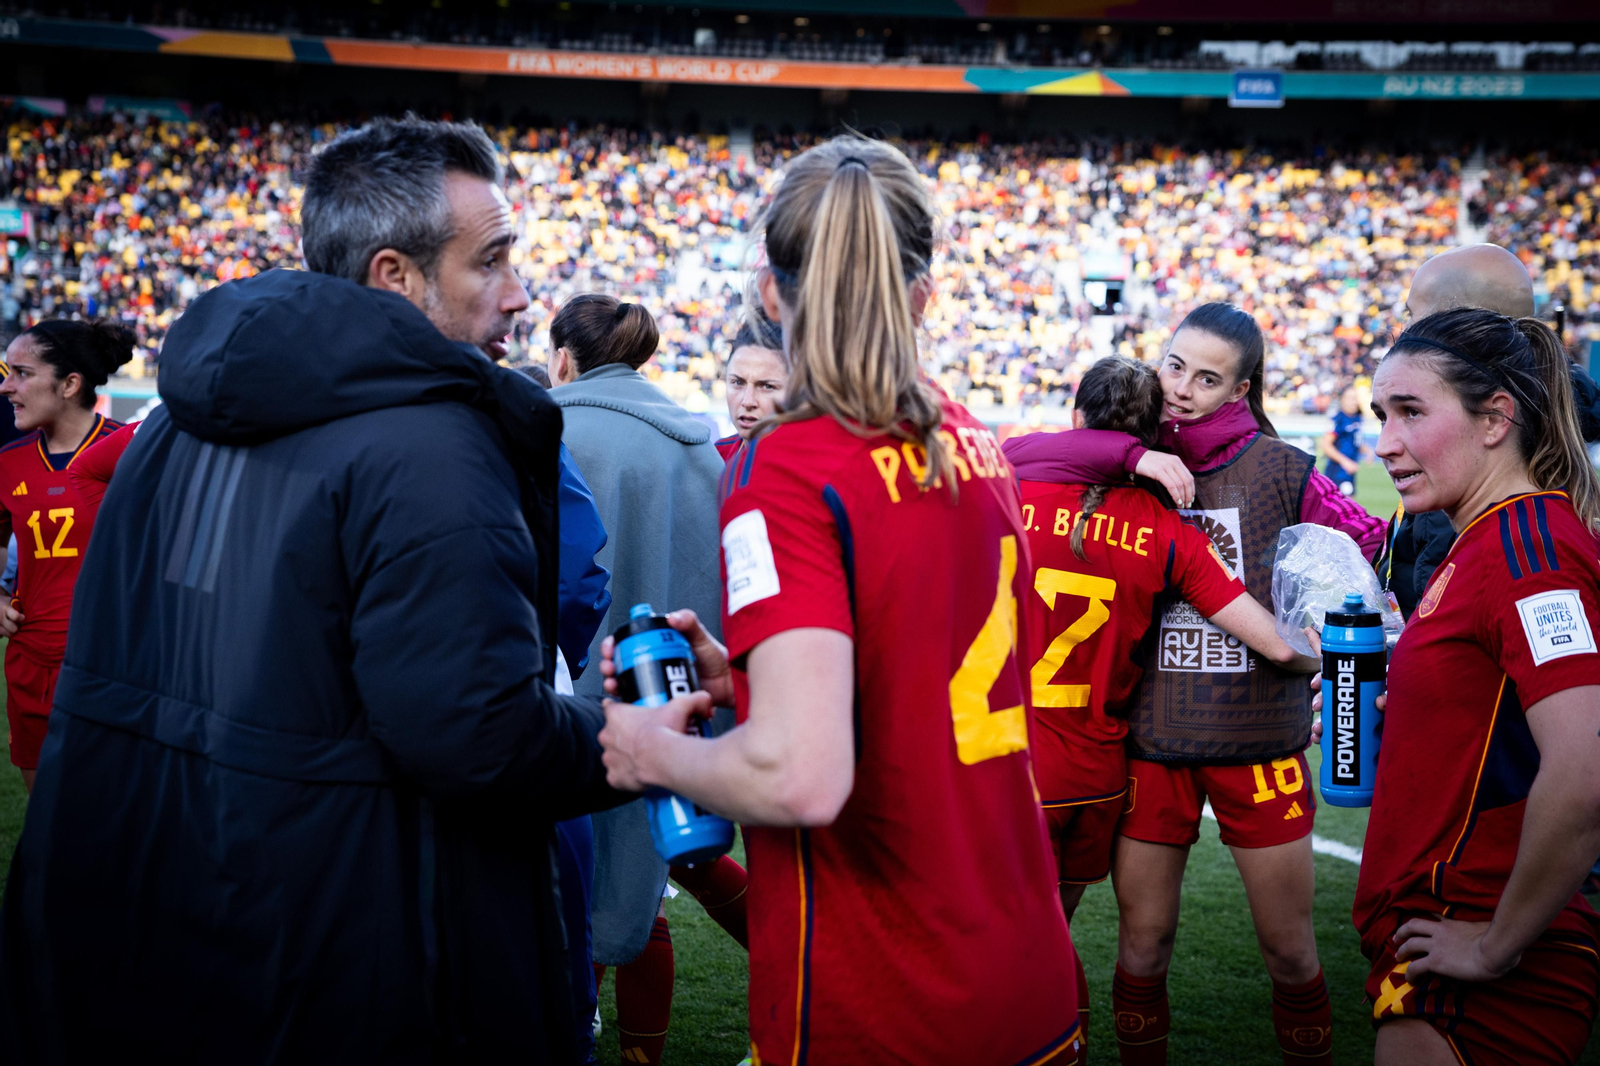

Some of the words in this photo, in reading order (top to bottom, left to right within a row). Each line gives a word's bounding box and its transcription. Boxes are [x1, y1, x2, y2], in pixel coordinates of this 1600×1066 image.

[508, 53, 550, 73] FIFA
[554, 55, 654, 78] WOMEN'S
[656, 60, 732, 81] WORLD
[734, 63, 781, 83] CUP
[1237, 77, 1276, 95] FIFA
[1458, 75, 1525, 97] 2023
[27, 507, 78, 559] 12
[1053, 508, 1153, 557] BATLLE
[1533, 601, 1569, 616] FOOTBALL
[1165, 616, 1205, 625] WORLD
[1536, 610, 1573, 627] UNITES
[1030, 567, 1116, 708] 2
[1538, 627, 1552, 639] the
[1553, 621, 1578, 634] World
[1164, 631, 1199, 649] AU
[1553, 635, 1571, 645] FIFA
[1164, 649, 1199, 667] NZ
[1207, 651, 1242, 667] 23
[1337, 658, 1355, 778] POWERADE
